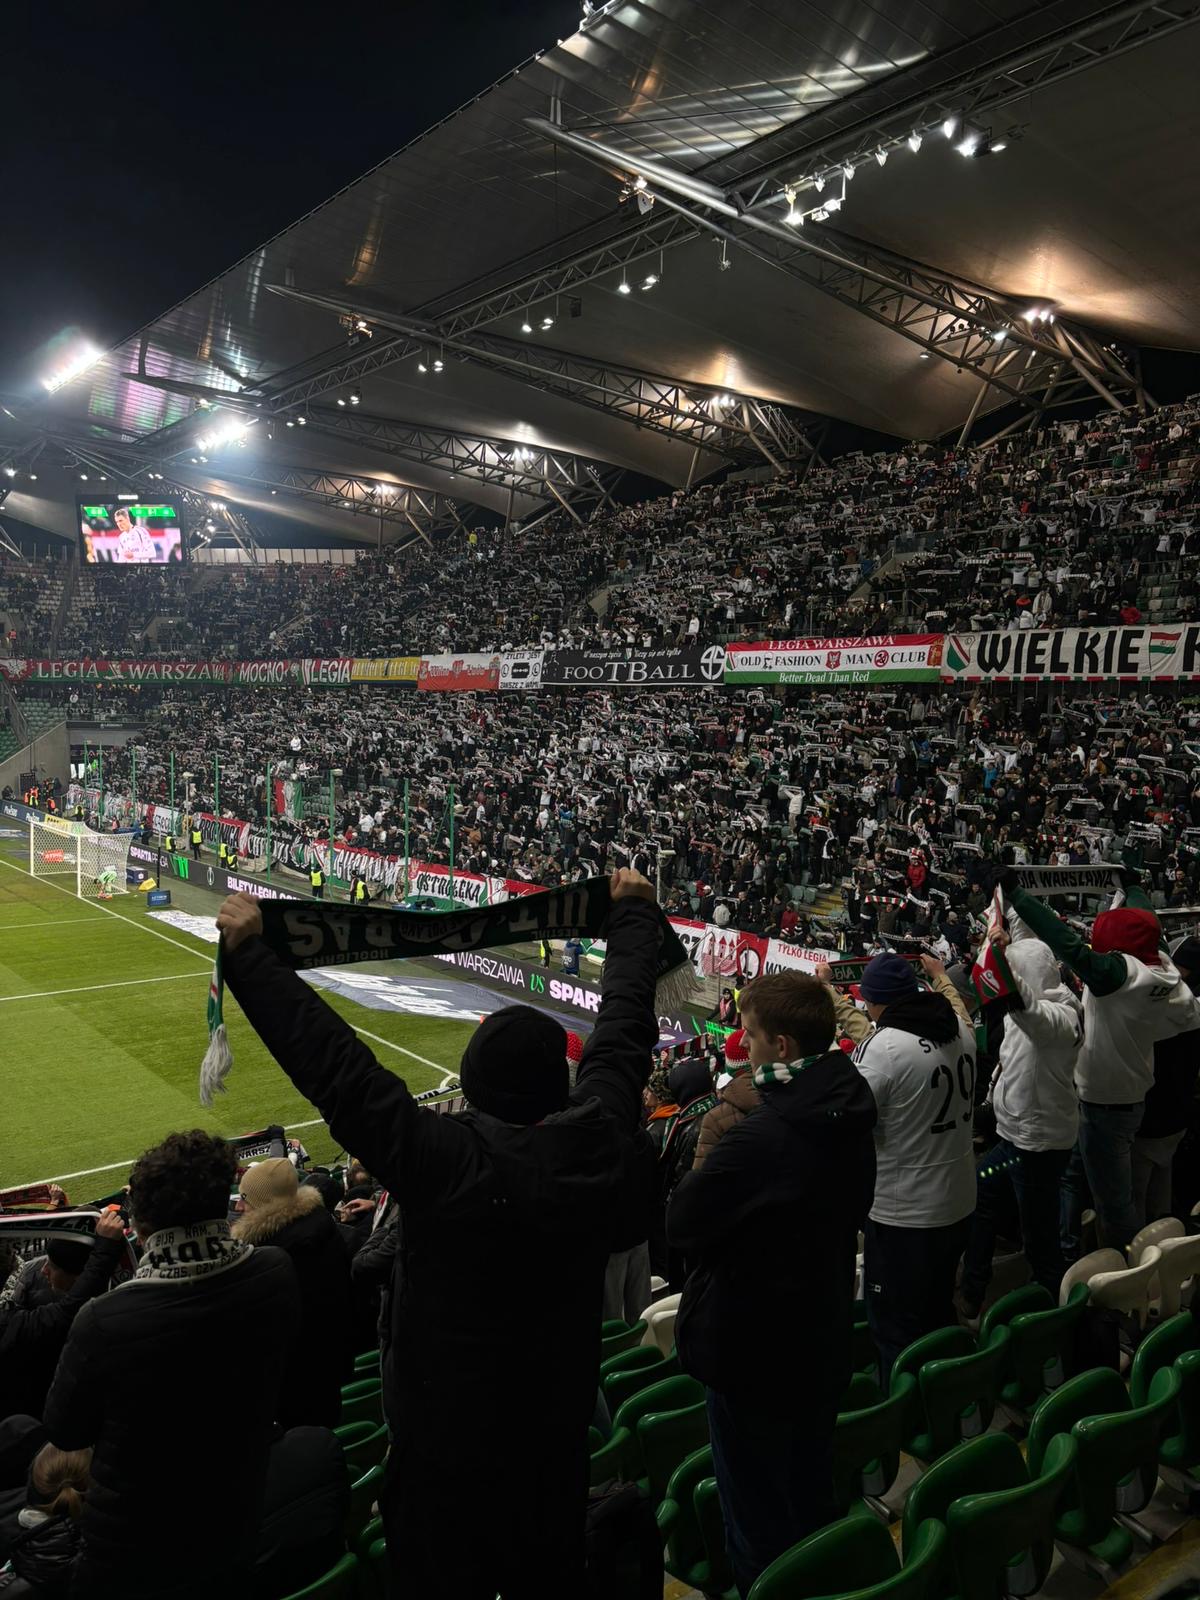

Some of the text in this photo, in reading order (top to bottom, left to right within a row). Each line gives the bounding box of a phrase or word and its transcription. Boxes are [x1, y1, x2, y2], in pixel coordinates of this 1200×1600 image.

[769, 635, 894, 650] LEGIA WARSZAWA
[976, 629, 1144, 674] WIELKIE
[740, 651, 926, 667] OLD FASHION MAN CLUB
[37, 662, 225, 680] LEGIA WARSZAWA
[239, 661, 284, 683] MOCNO
[311, 659, 351, 683] LEGIA
[779, 670, 870, 683] Better Dead Than Red
[152, 853, 168, 868] PRGA
[1039, 870, 1115, 889] WARSZAWA
[777, 943, 827, 963] TYLKO LEGIA
[456, 953, 524, 988] WARSZAWA
[931, 1053, 974, 1134] 29
